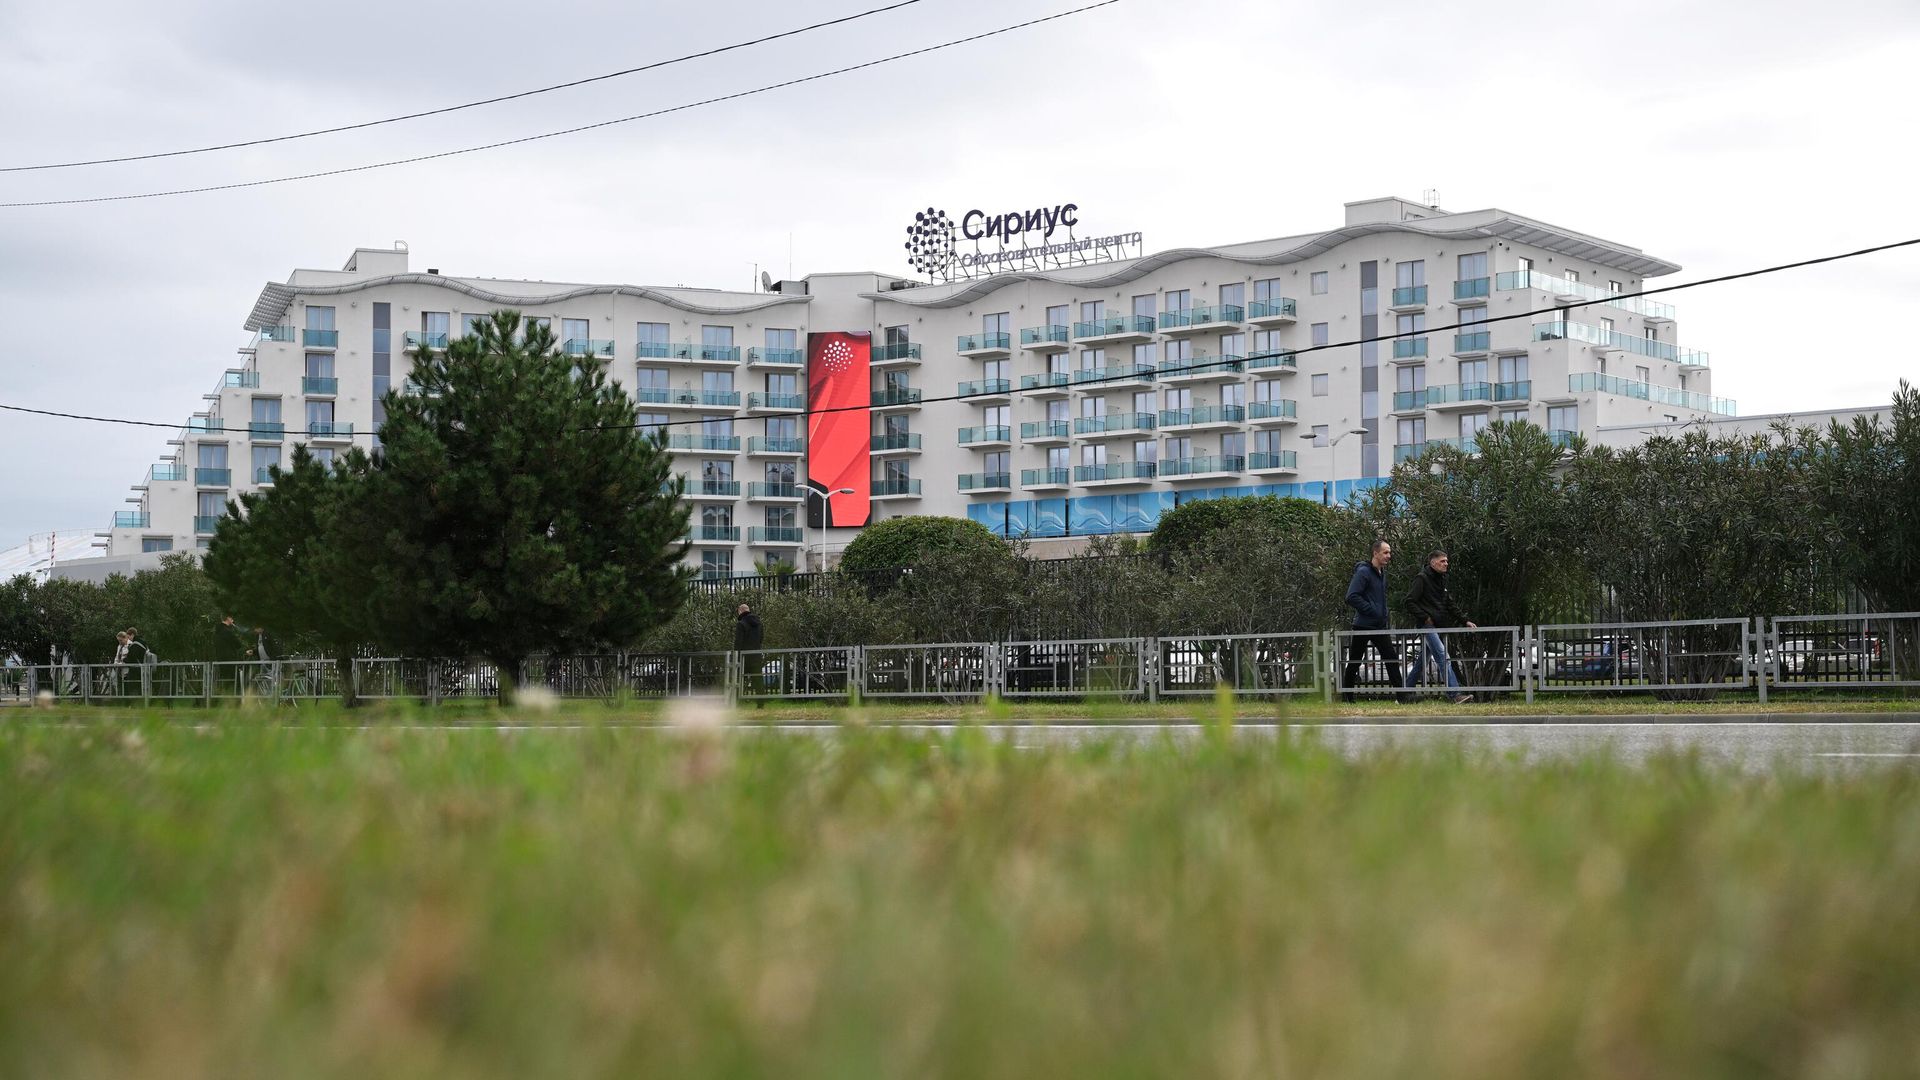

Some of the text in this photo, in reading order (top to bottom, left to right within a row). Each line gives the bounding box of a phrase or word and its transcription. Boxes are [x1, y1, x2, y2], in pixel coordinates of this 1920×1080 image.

[962, 203, 1079, 244] Сириус
[961, 231, 1142, 268] Образовательный центр
